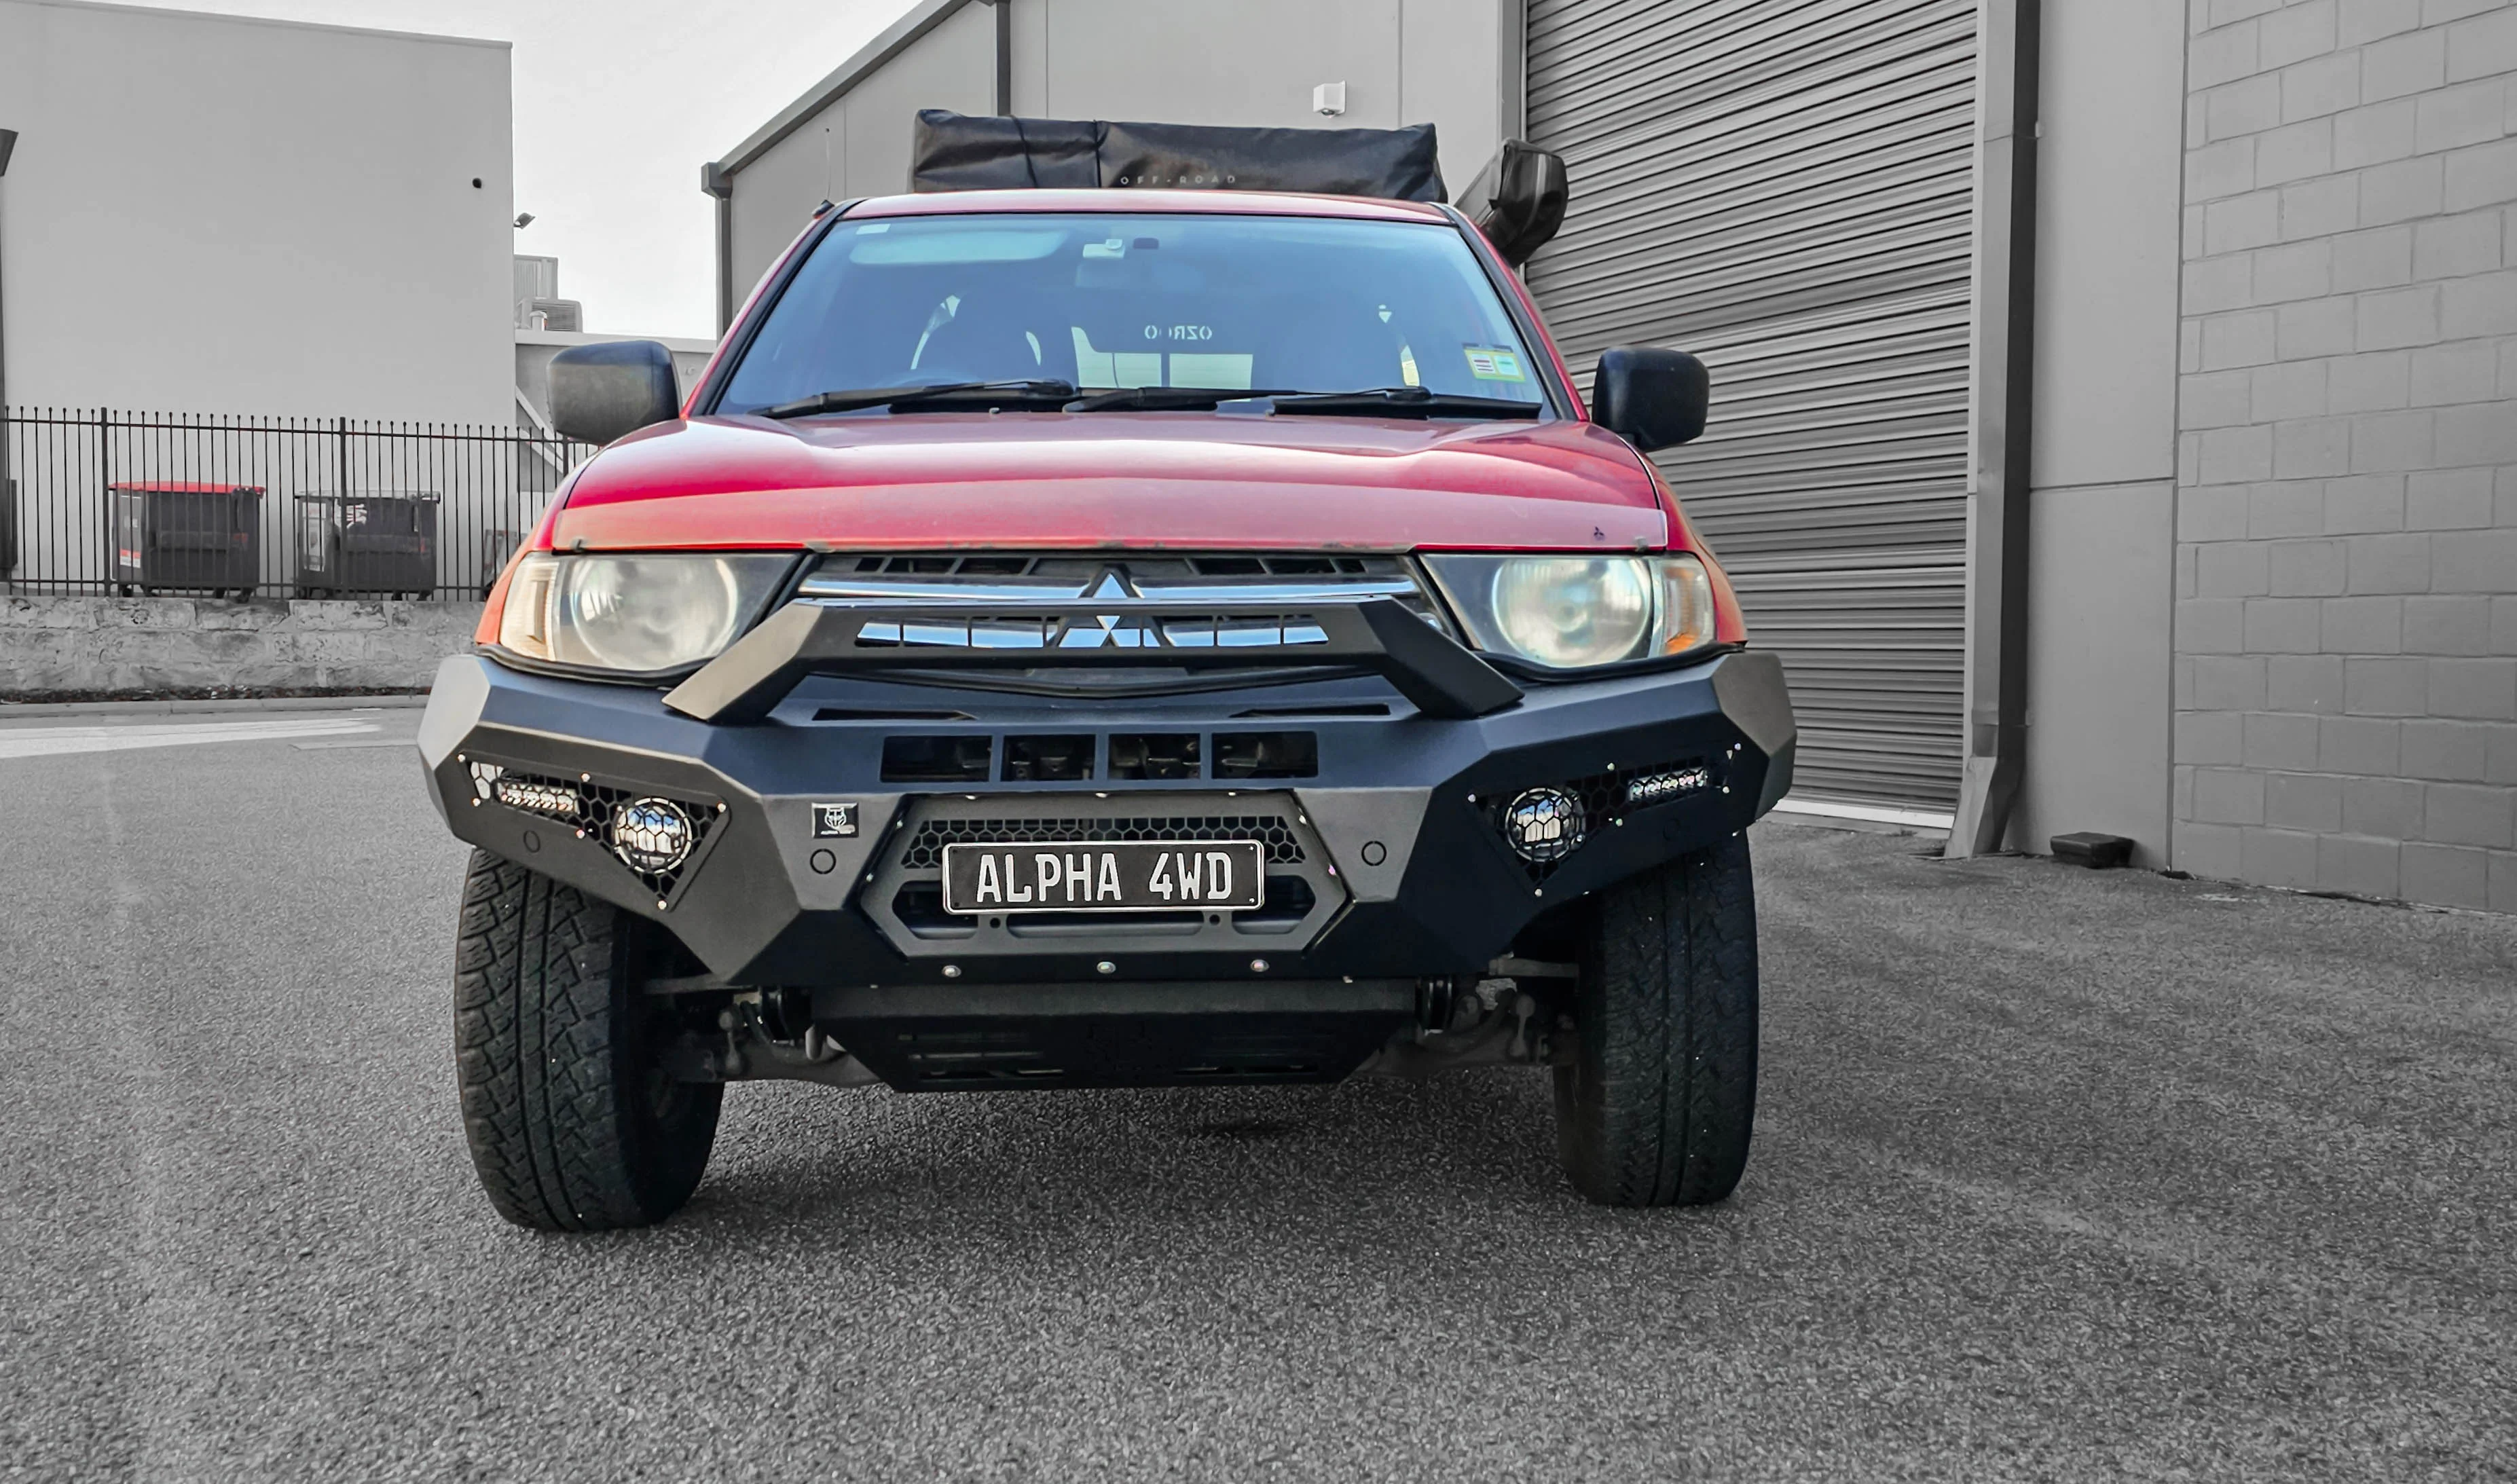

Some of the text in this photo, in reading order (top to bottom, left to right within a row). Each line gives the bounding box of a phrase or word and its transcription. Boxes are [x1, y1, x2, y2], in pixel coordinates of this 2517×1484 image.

[1120, 175, 1236, 185] OFF-ROAD
[976, 852, 1232, 903] ALPHA 4WD
